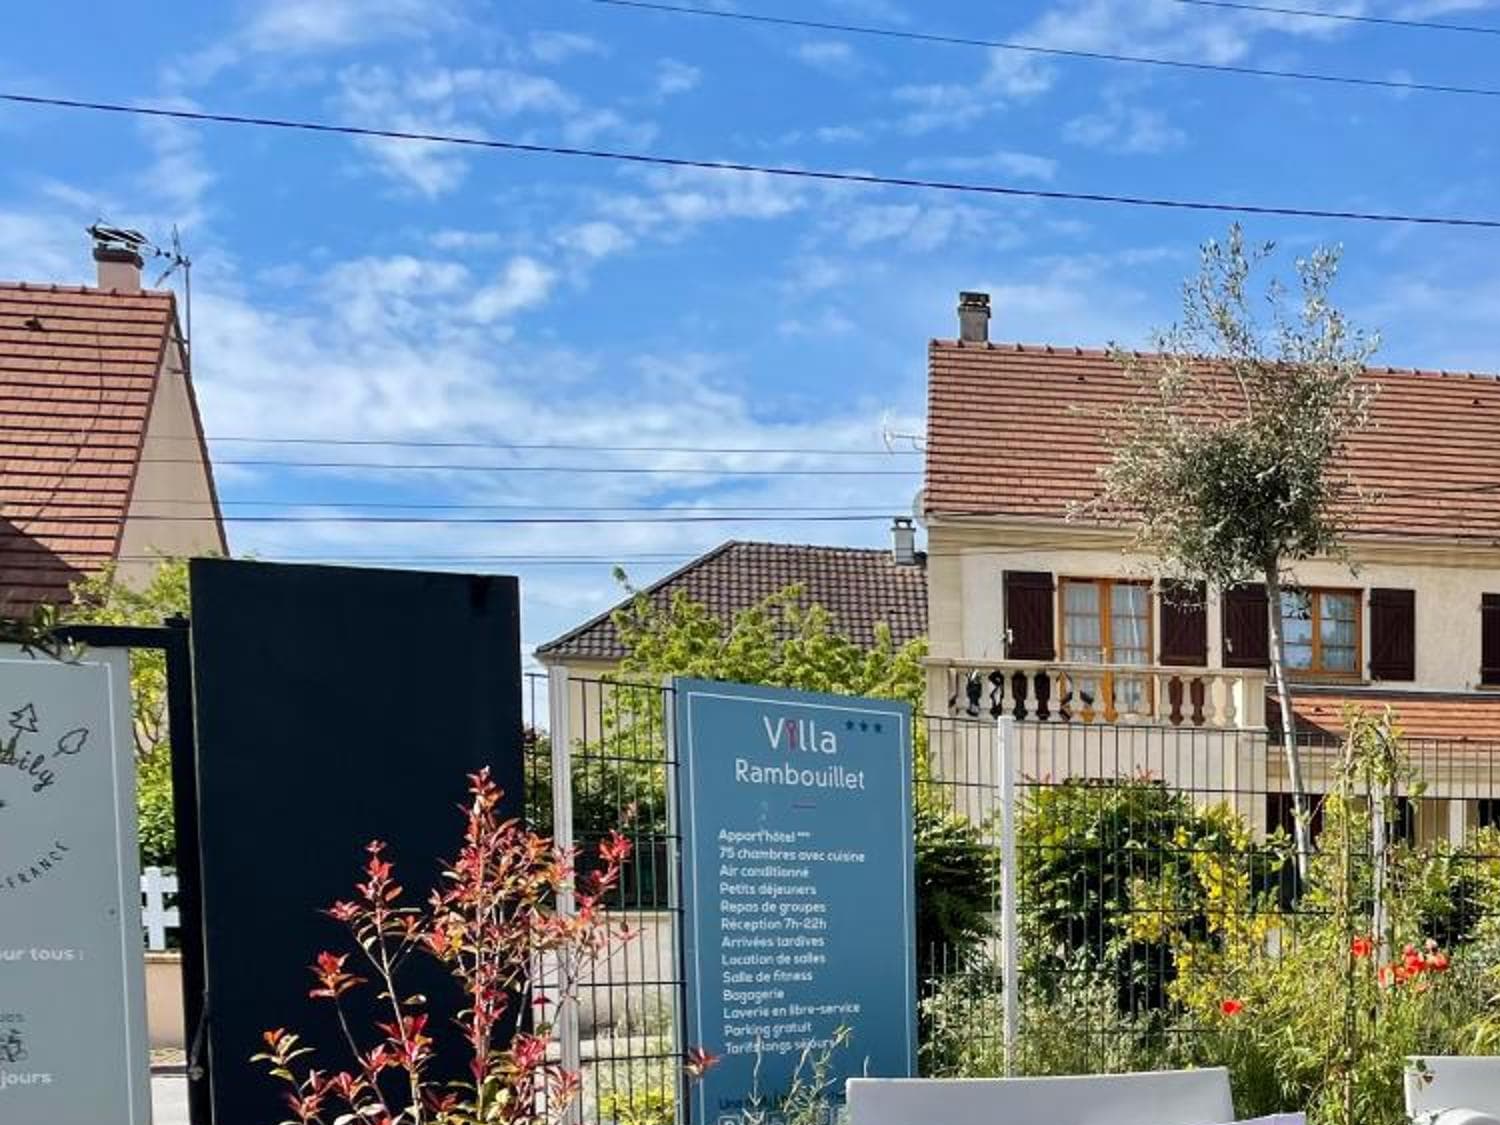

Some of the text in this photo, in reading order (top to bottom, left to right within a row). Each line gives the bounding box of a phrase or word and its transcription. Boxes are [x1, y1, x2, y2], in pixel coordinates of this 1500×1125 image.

[763, 715, 838, 753] Villa
[735, 758, 865, 790] Rambouillet
[720, 847, 865, 862] 75 chambres avec cuisine
[719, 865, 738, 877] Air
[719, 882, 817, 898] Petits déjeuners
[721, 900, 826, 916] Repas de groupes
[721, 917, 827, 932] Réception 7h-22h
[722, 935, 825, 948] Arrivées tardives
[721, 951, 826, 965] Location de salles
[723, 969, 813, 983] Salle de fitness
[723, 987, 785, 1004] Bagagerie
[723, 1003, 861, 1019] Laverie en libre-service
[724, 1022, 812, 1038] Parking gratuit
